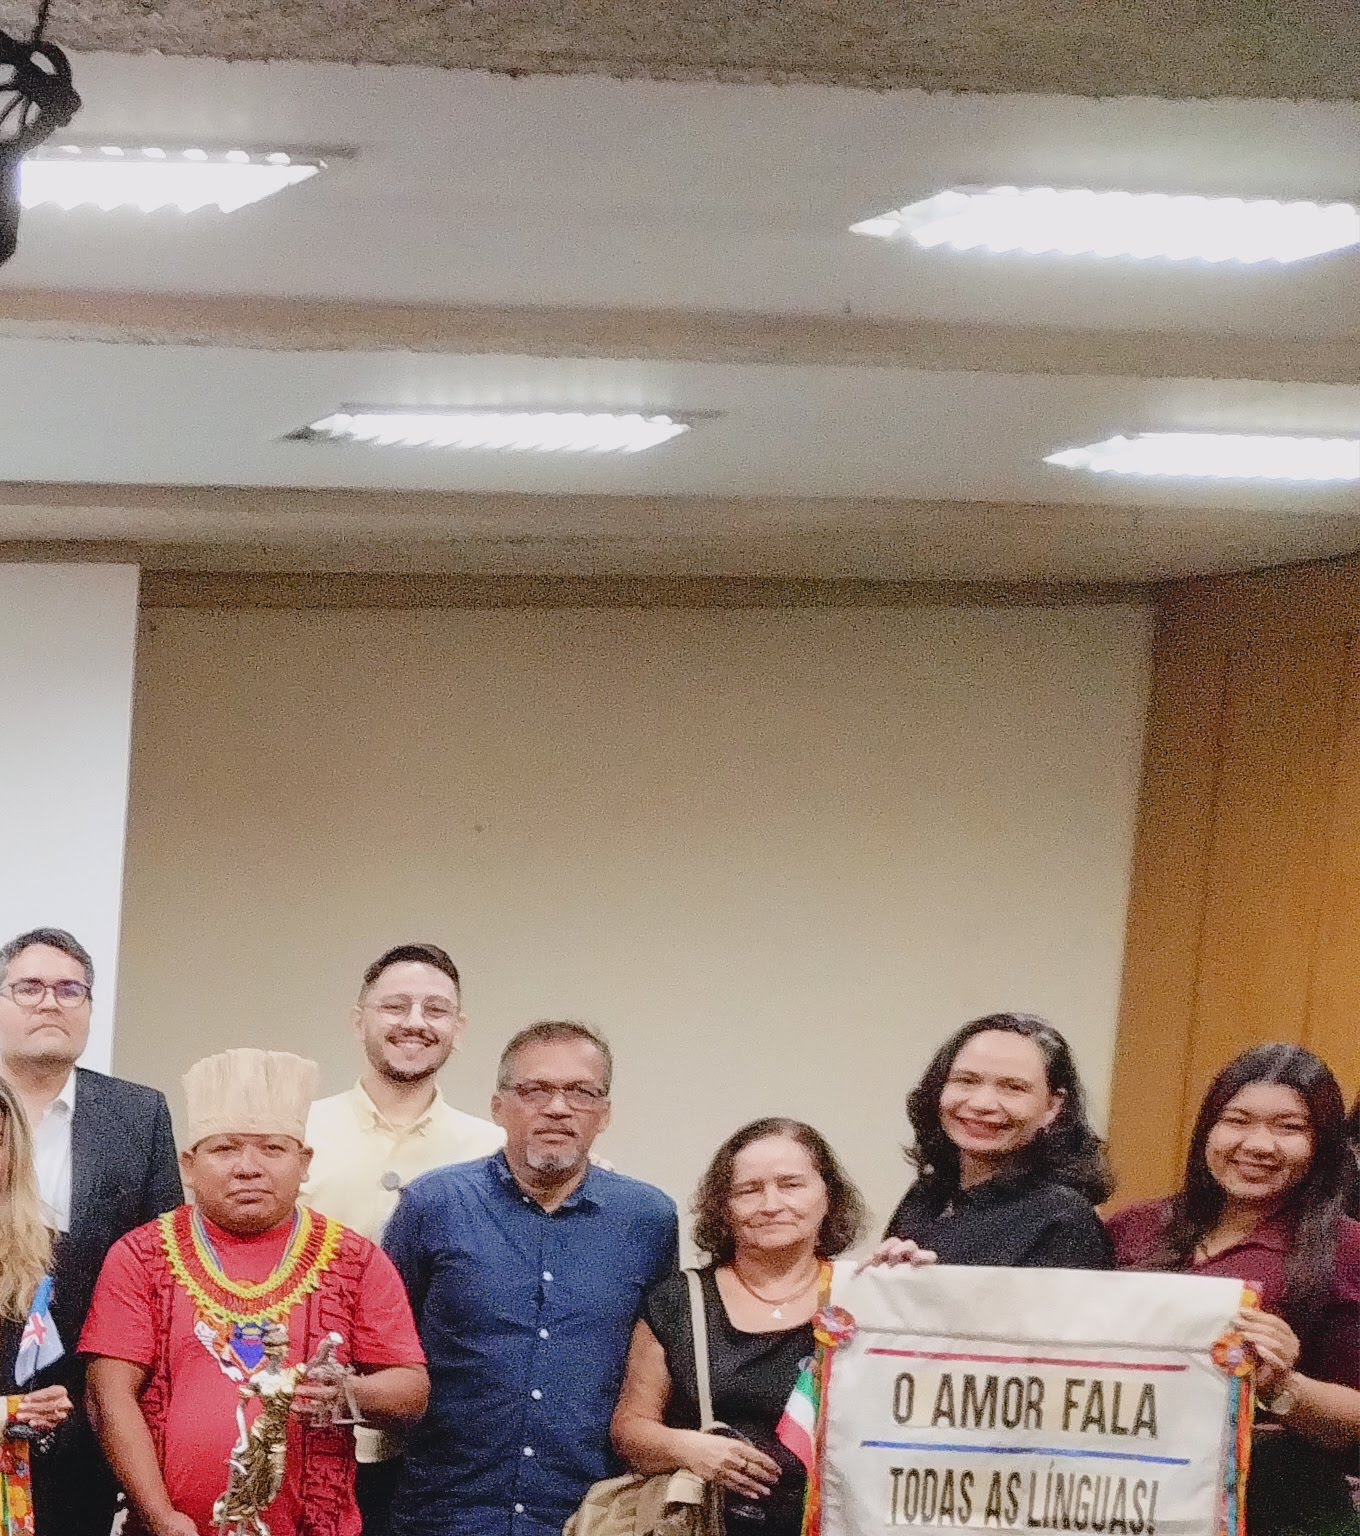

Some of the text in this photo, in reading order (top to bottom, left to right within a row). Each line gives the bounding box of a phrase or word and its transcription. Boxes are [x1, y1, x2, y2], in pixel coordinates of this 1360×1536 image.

[892, 1371, 1158, 1439] O AMOR FALA
[889, 1460, 1160, 1536] TODAS AS LÍNGUAS!
